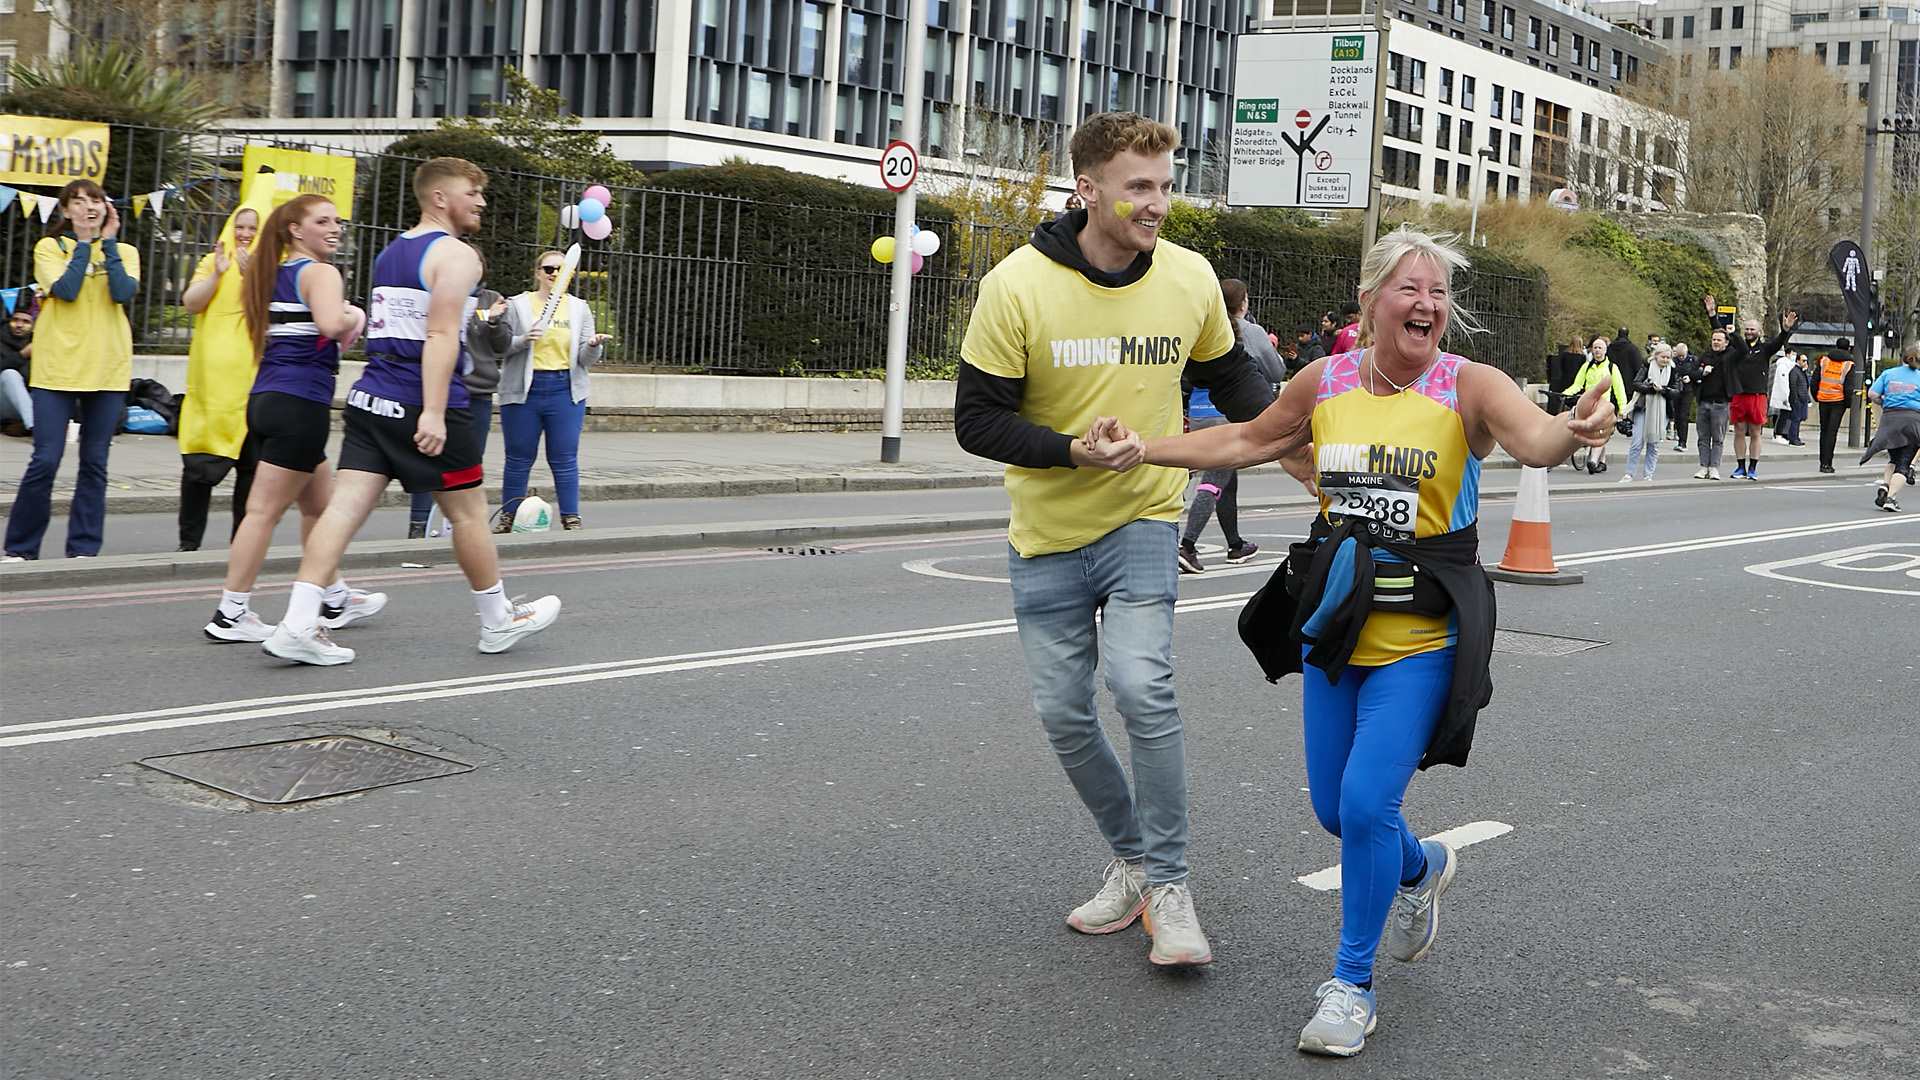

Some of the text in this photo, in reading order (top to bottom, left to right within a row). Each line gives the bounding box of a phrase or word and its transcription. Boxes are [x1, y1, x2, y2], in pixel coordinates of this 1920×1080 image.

[1333, 38, 1363, 48] Tilbury
[1333, 47, 1360, 57] (A13)
[1330, 66, 1374, 74] Docklands
[1329, 76, 1358, 84] A1203
[1329, 88, 1357, 97] ExCeL
[1238, 101, 1278, 111] Ring road
[1328, 101, 1369, 109] Blackwall
[1247, 111, 1267, 120] N&S
[1334, 111, 1362, 119] Tunnel
[1234, 128, 1265, 137] Aldgate
[1326, 126, 1344, 135] City
[1234, 138, 1278, 146] Shoreditch
[0, 133, 103, 177] MiNDS
[1233, 148, 1283, 156] Whitechapel
[1233, 157, 1286, 166] Tower Bridge
[886, 156, 913, 177] 20
[1316, 176, 1340, 184] Except
[1348, 476, 1384, 486] MAXINE
